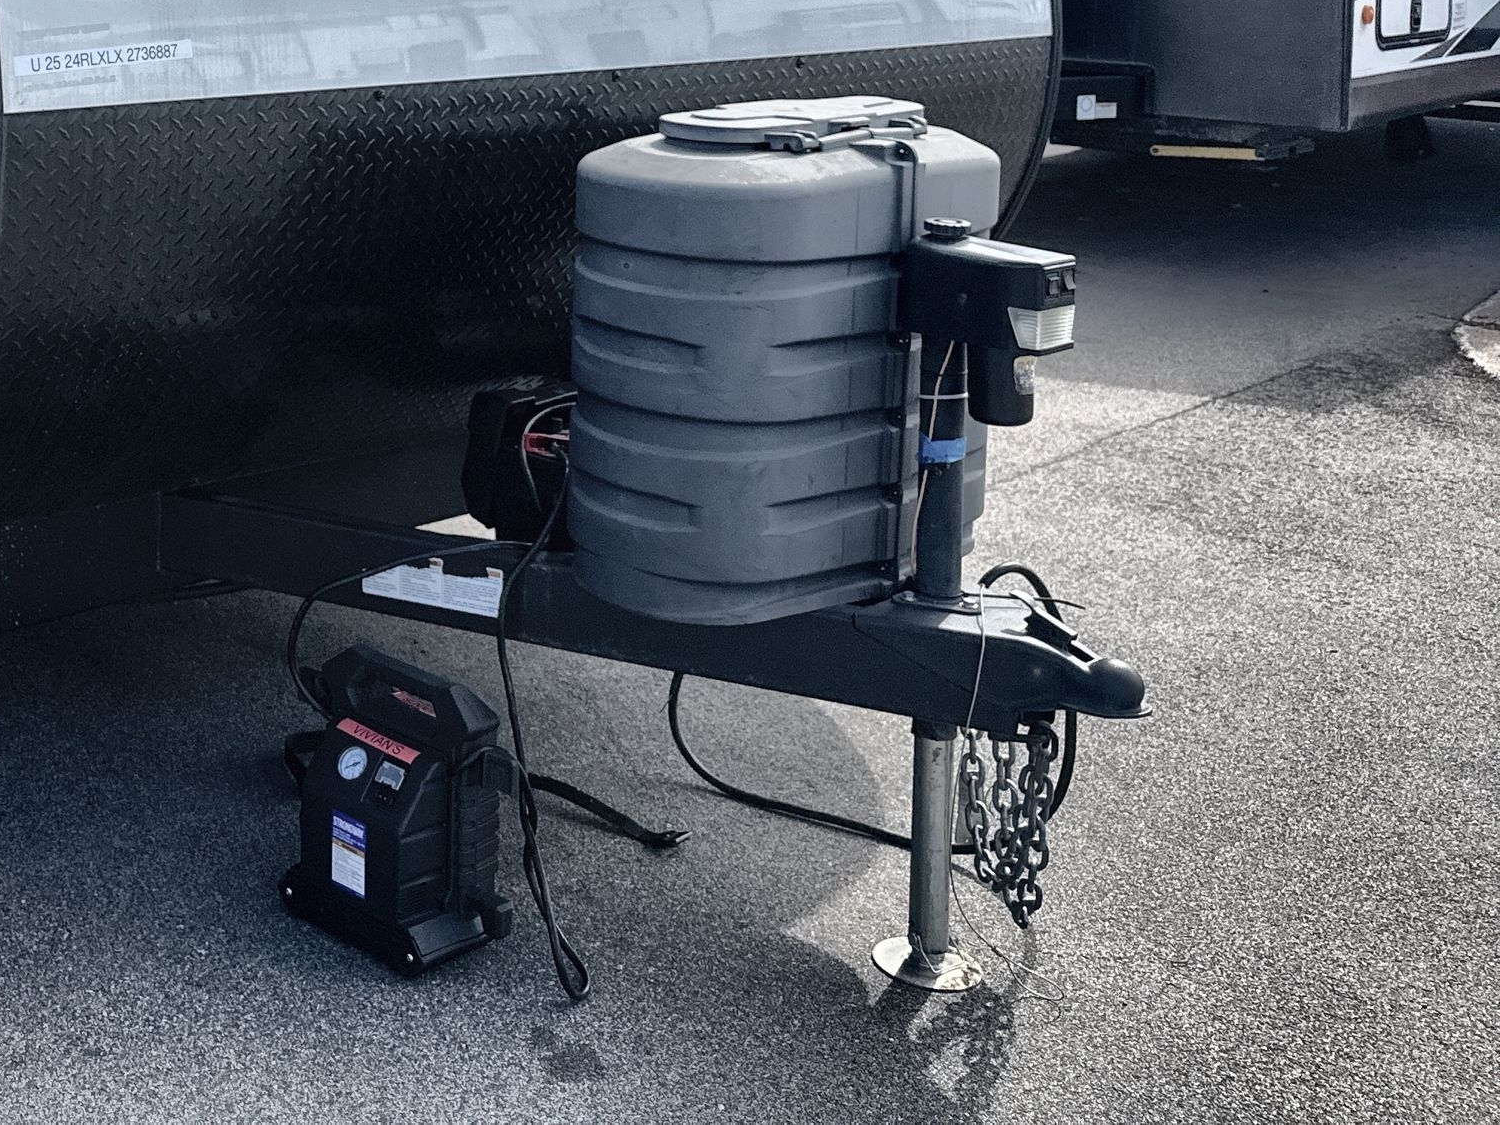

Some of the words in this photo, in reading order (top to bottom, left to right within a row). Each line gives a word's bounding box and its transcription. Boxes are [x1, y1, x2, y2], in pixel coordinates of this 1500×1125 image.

[30, 57, 41, 73] U
[45, 55, 61, 71] 25
[64, 49, 124, 69] 24RLXLX
[126, 43, 178, 63] 2736887
